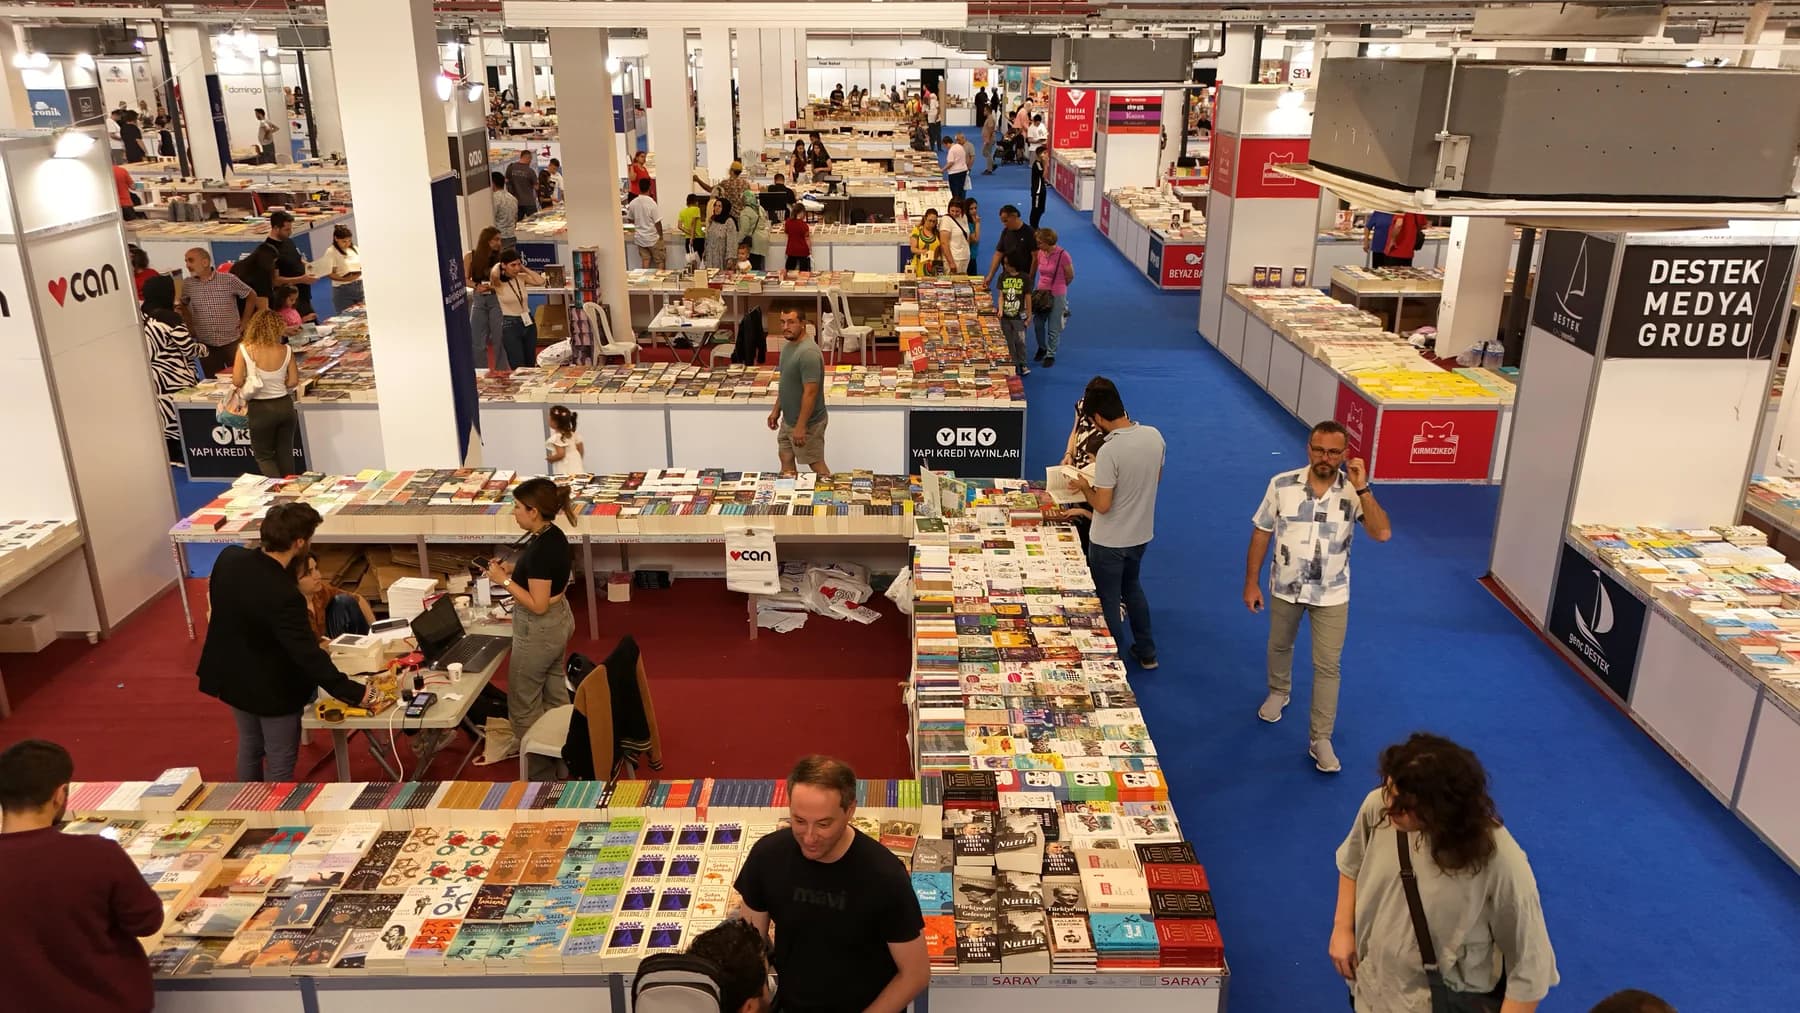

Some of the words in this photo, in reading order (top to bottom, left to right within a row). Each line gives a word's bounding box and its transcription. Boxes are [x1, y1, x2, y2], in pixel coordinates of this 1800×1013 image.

[228, 86, 262, 95] domingo
[1169, 269, 1193, 279] BEYAZ
[1649, 259, 1765, 285] DESTEK
[70, 263, 119, 302] can
[1643, 291, 1753, 316] MEDYA
[1553, 312, 1580, 333] DESTEK
[1638, 323, 1752, 347] GRUBU
[939, 430, 994, 443] YKY
[190, 448, 214, 457] YAPI
[216, 446, 247, 457] KREDİ
[912, 449, 934, 458] YAPI
[936, 448, 967, 458] KREDİ
[968, 449, 1020, 458] YAYINLARI
[741, 550, 771, 562] can
[1583, 644, 1611, 676] DESTEK
[997, 836, 1034, 849] Nutuk
[793, 887, 848, 911] mavi
[1001, 897, 1041, 906] Nutuk
[1003, 936, 1045, 950] Nutuk
[992, 976, 1041, 985] SARAY
[1161, 977, 1209, 986] SARAY
